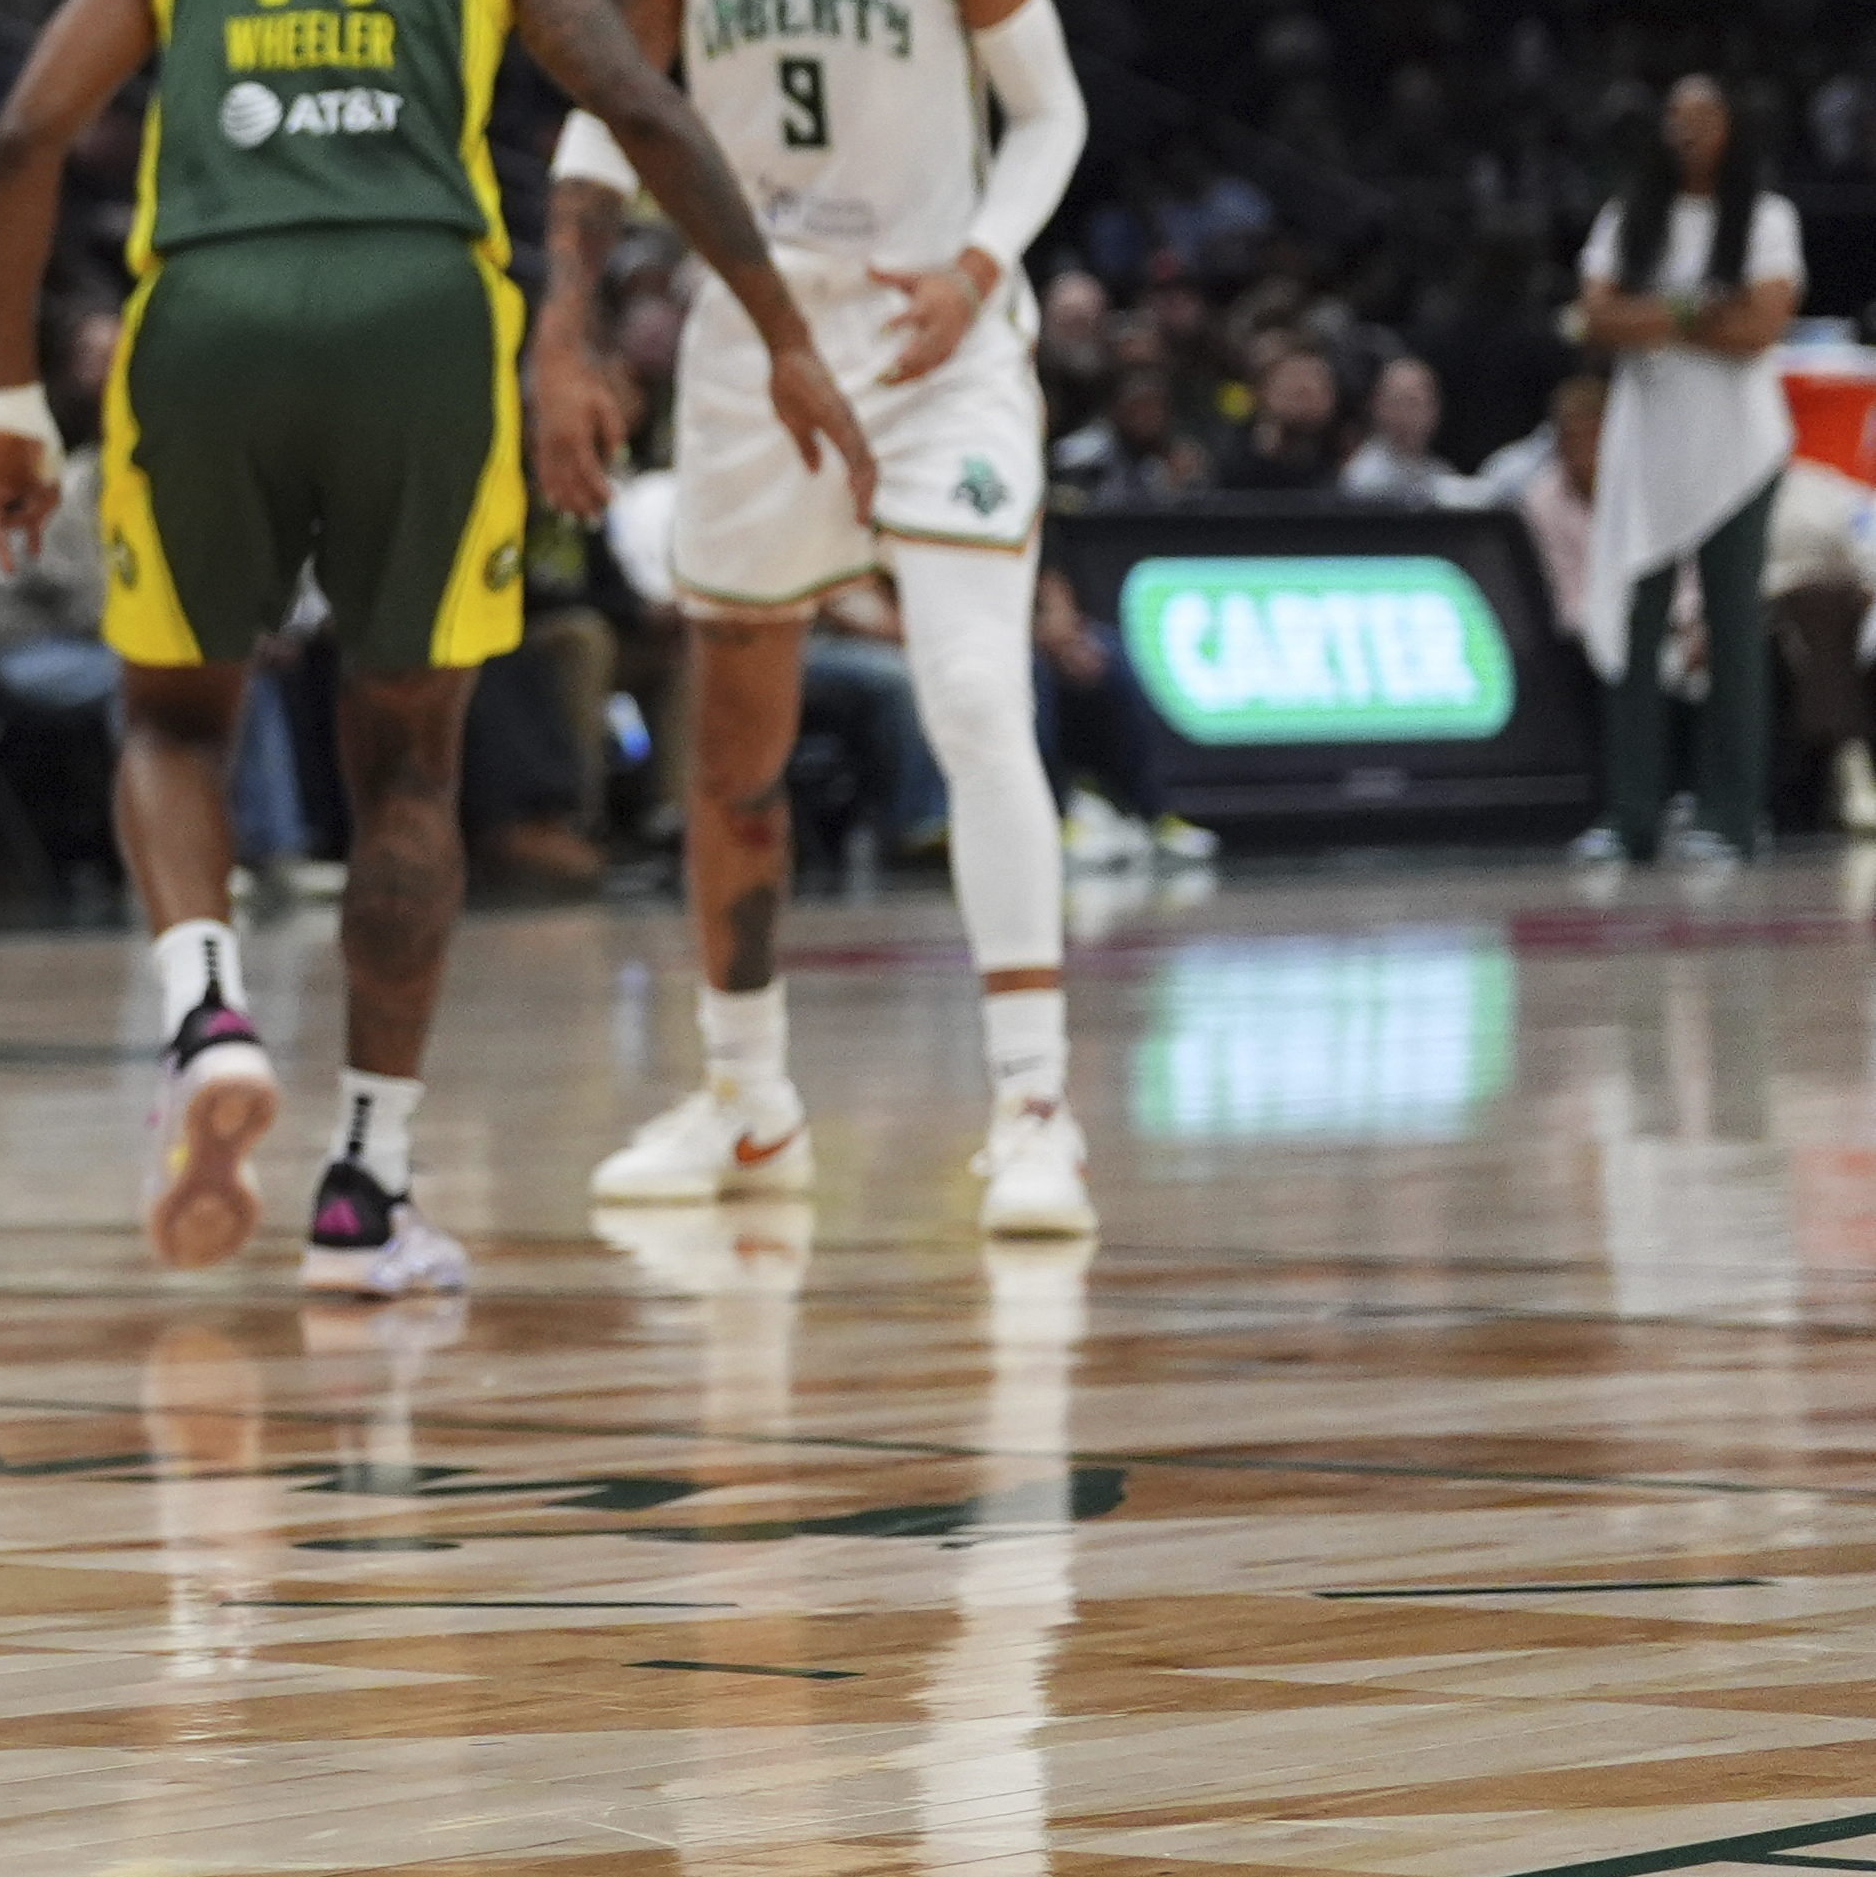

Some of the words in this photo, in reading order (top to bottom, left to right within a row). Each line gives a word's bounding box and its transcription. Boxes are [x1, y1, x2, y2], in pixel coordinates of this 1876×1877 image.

[224, 9, 396, 72] WHEELER
[284, 87, 403, 137] AT&T
[777, 54, 830, 151] 9
[1161, 591, 1479, 713] CARTER
